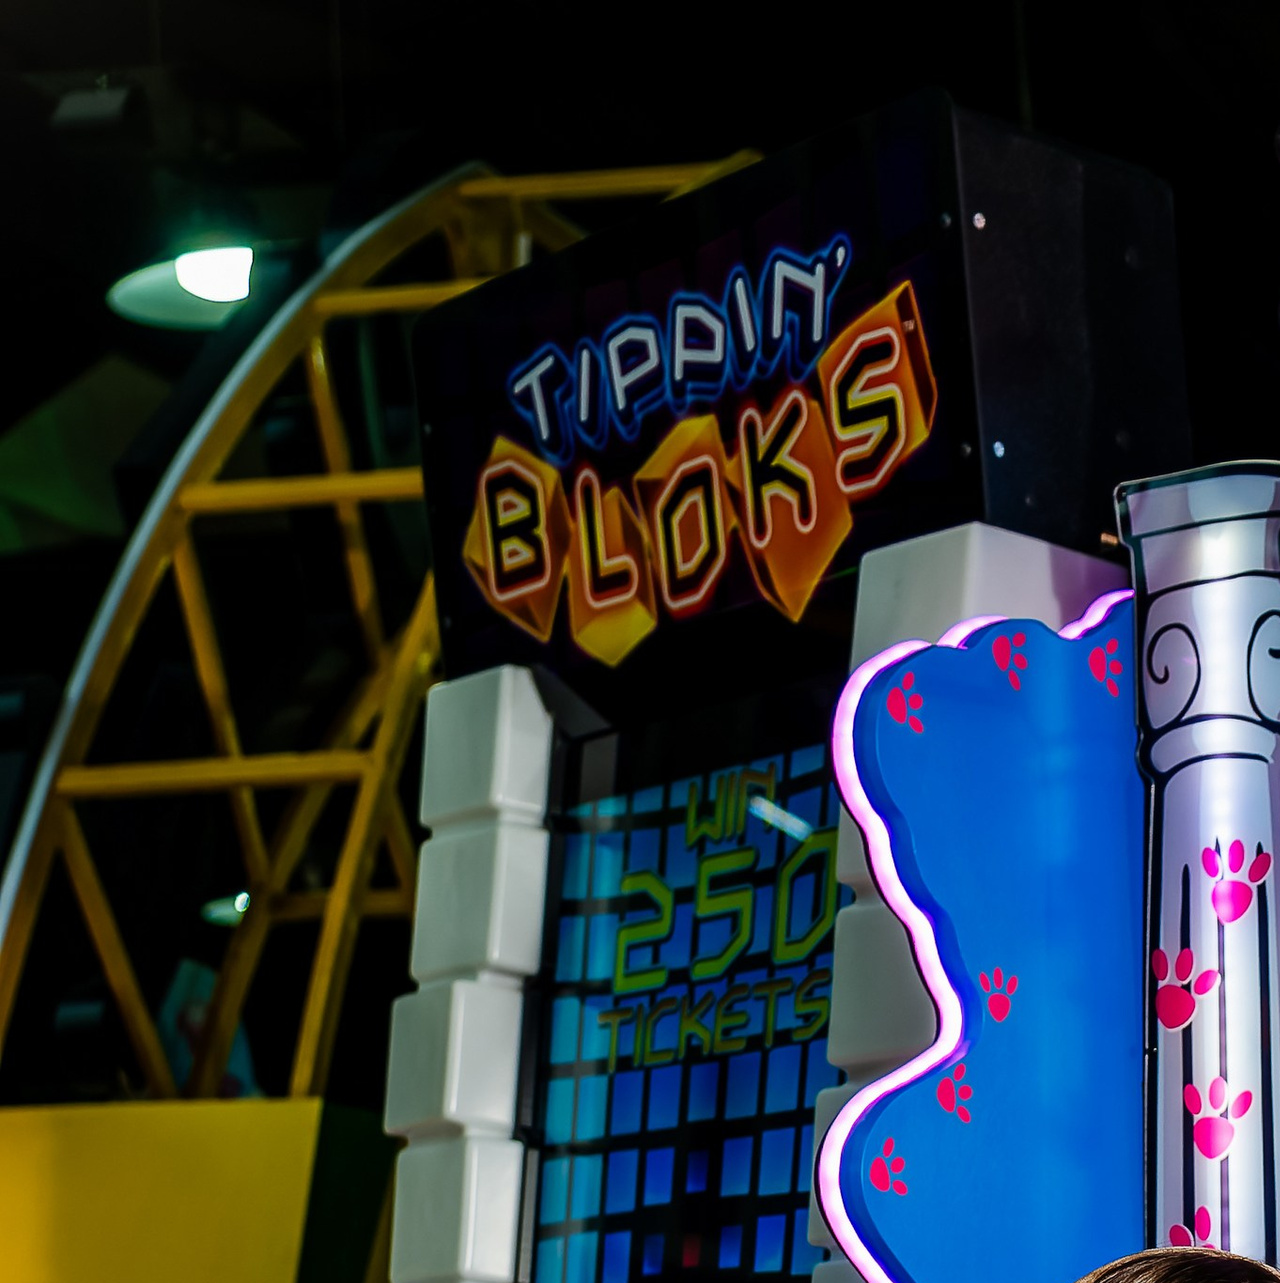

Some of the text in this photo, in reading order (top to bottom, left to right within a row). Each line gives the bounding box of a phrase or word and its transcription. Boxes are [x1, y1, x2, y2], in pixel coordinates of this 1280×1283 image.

[479, 325, 907, 610] BLOKS
[685, 761, 778, 849] WIN
[612, 826, 840, 995] 250
[597, 967, 832, 1074] TICKETS
